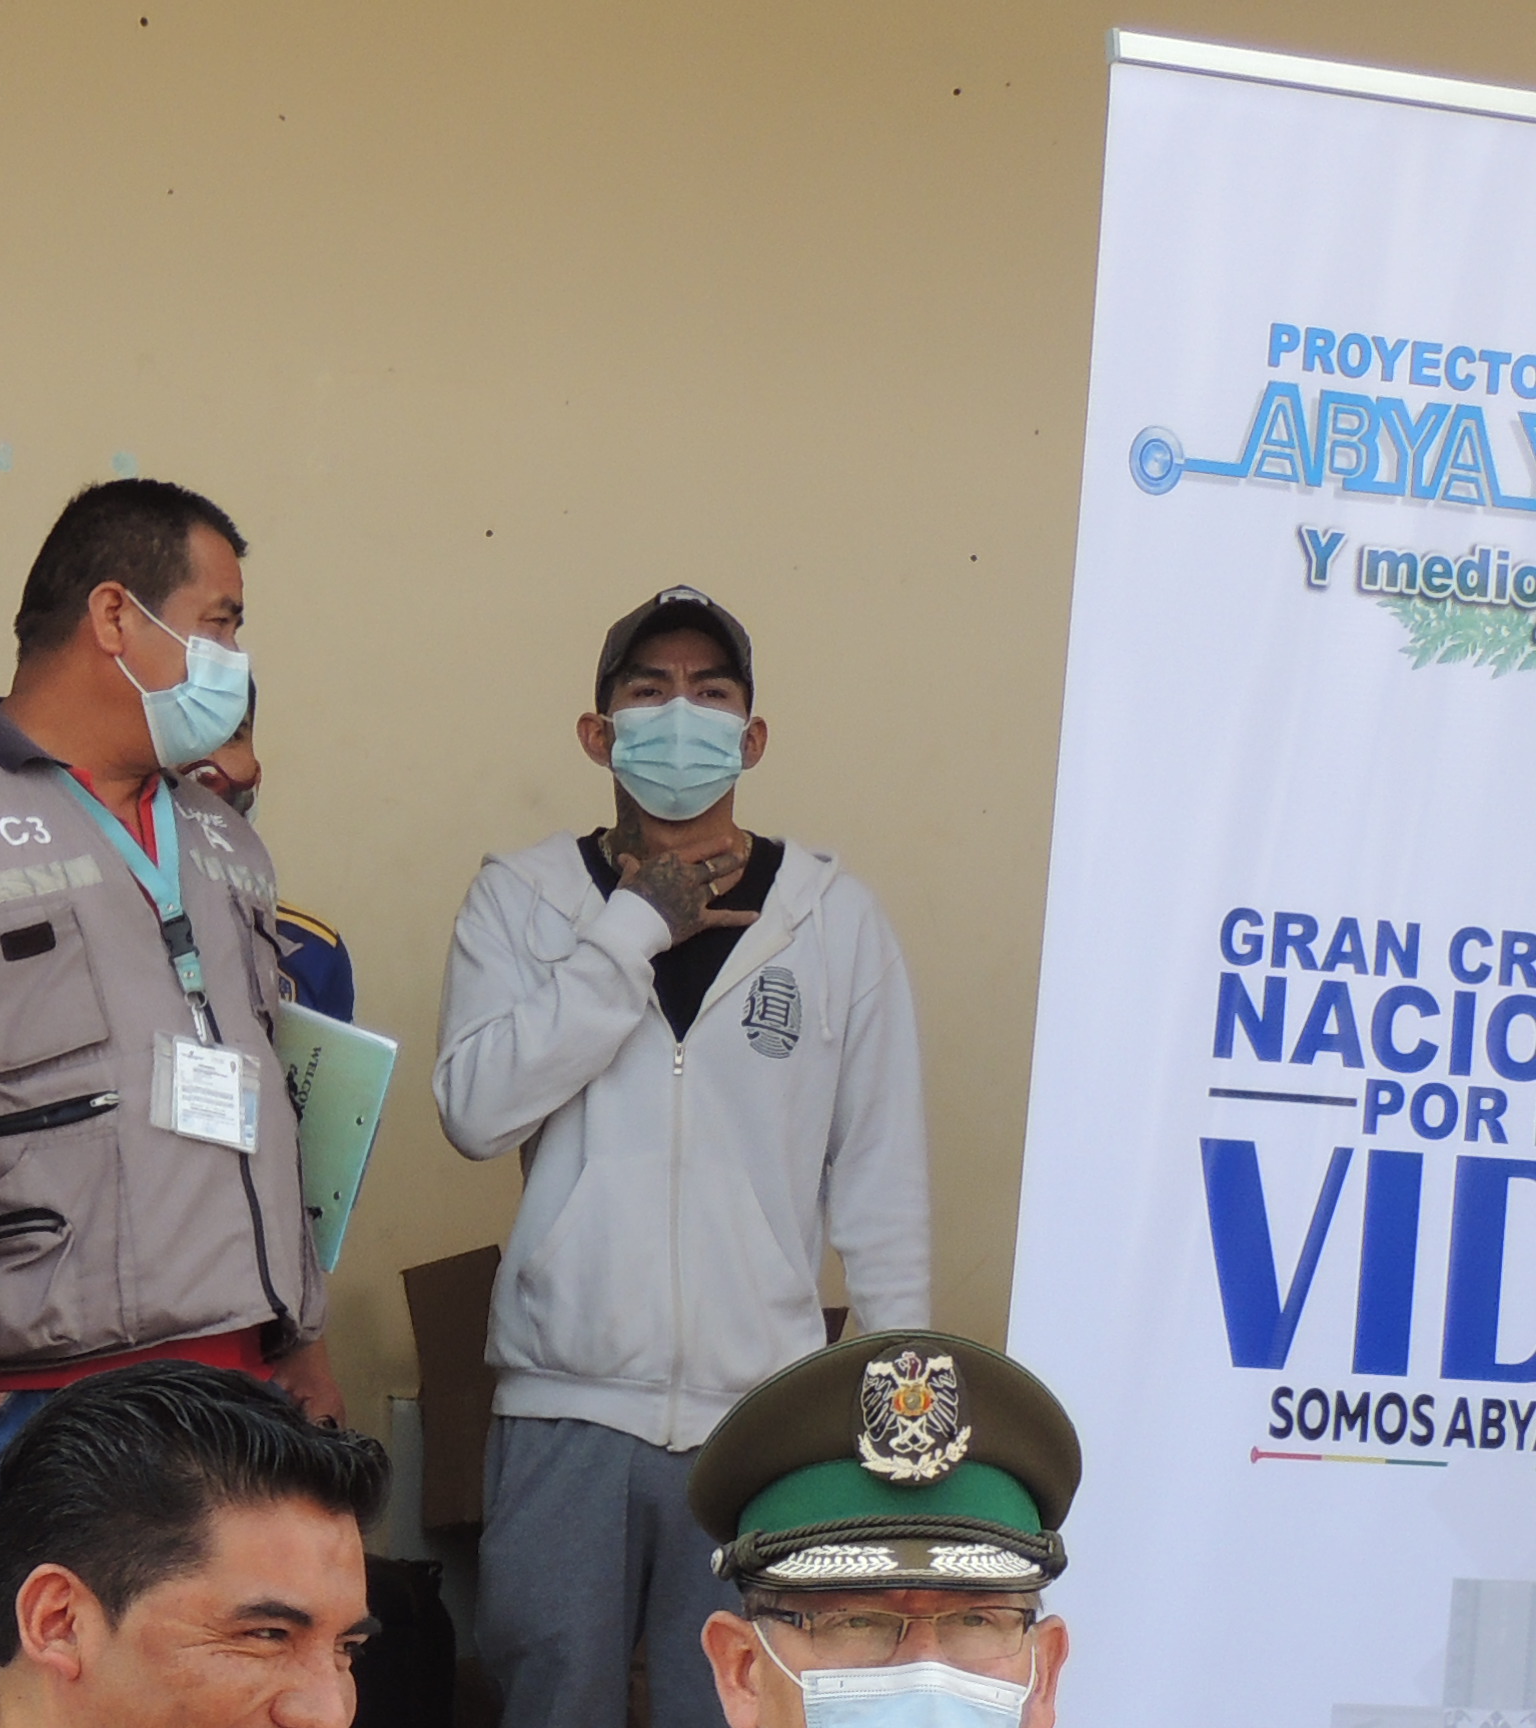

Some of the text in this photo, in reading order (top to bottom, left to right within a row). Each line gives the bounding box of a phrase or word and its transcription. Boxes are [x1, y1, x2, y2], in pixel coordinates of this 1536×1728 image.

[1299, 525, 1344, 588] Y
[1220, 907, 1421, 979] GRAN
[1362, 1078, 1509, 1144] POR
[1268, 1385, 1536, 1452] SOMOS ABY
